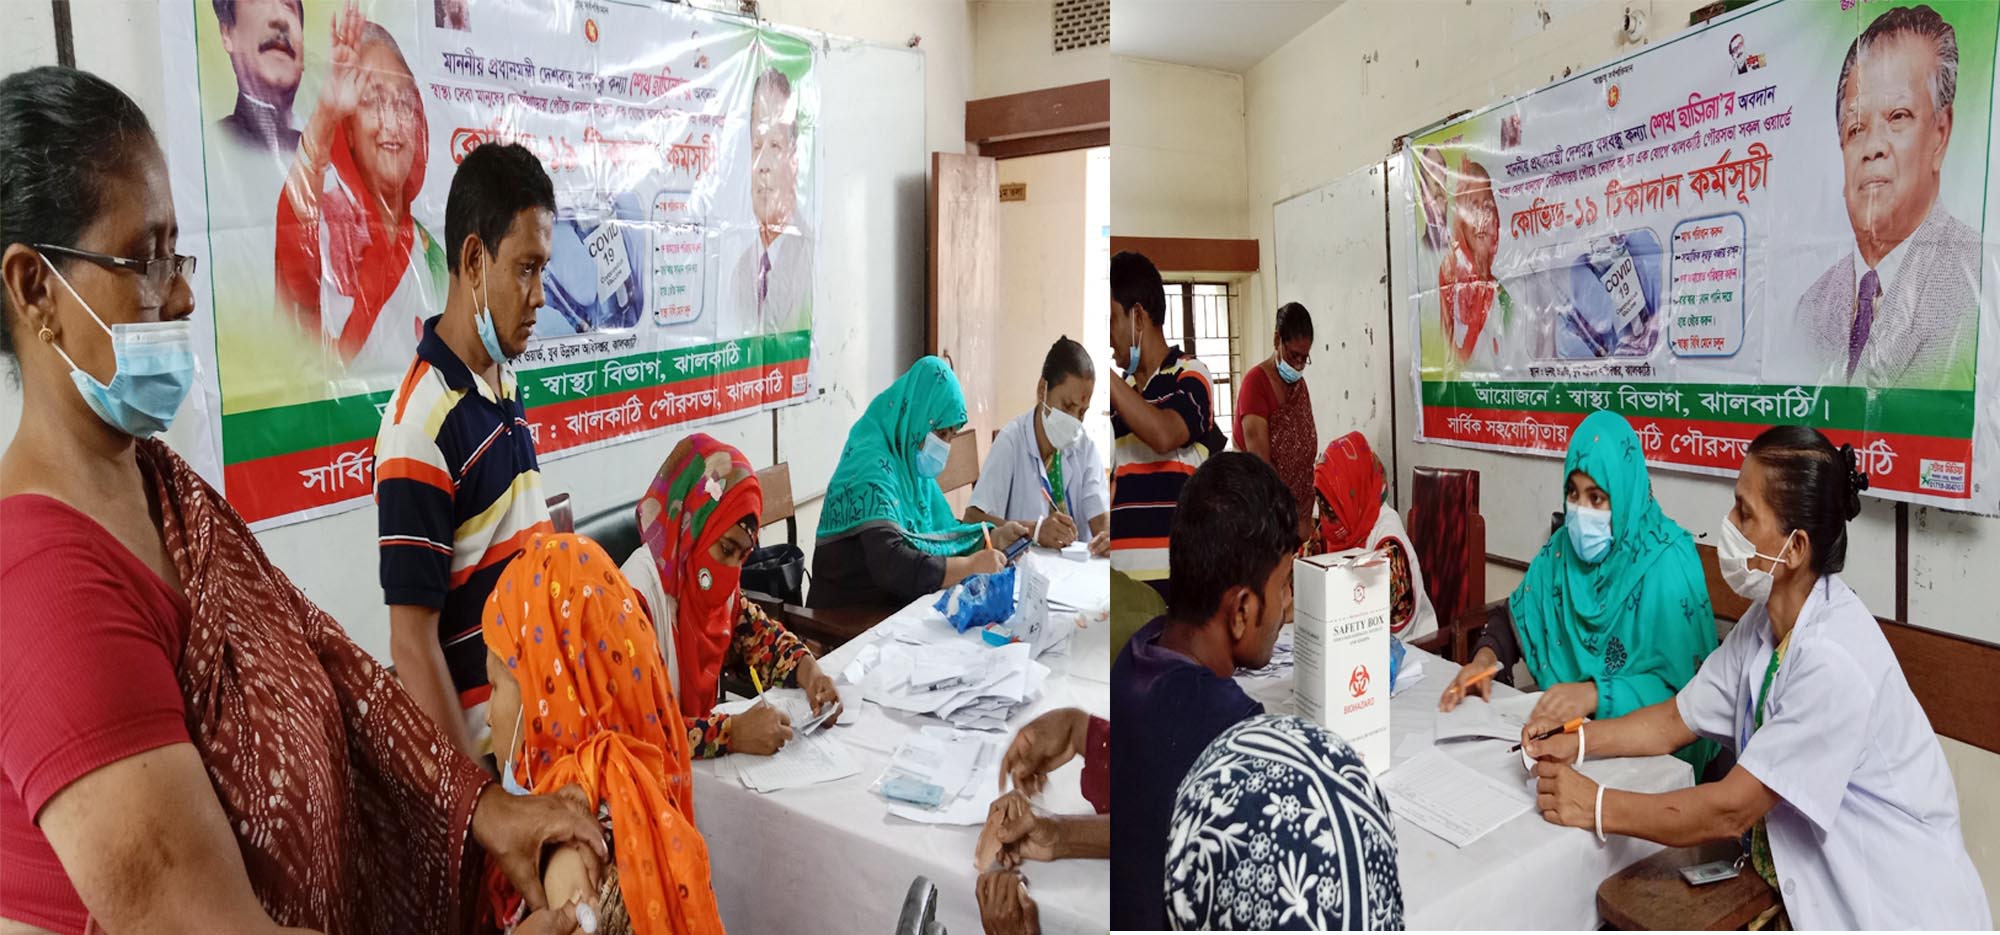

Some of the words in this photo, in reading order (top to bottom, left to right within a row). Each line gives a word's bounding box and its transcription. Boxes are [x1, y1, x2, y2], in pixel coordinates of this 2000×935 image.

[442, 47, 484, 77] মাননীয়
[629, 72, 653, 96] শেখ
[1566, 141, 1594, 161] দেশরত্ন
[1597, 131, 1625, 154] বঙ্গবন্ধু
[1625, 124, 1647, 144] কন্যা
[1650, 111, 1676, 139] শেখ
[1738, 84, 1777, 111] অবদান
[1671, 131, 1701, 154] ঝালকাঠি
[1703, 125, 1737, 147] পৌরসভা
[1738, 119, 1761, 138] সকল
[1763, 105, 1793, 131] ওয়ার্ডে
[1604, 178, 1683, 219] টিকাদান
[1687, 142, 1774, 205] কর্মসূচী
[588, 222, 619, 258] COVID
[603, 247, 615, 266] 19
[1605, 258, 1632, 293] COVID
[1619, 282, 1630, 299] 19
[540, 370, 598, 396] স্বাস্থ্য
[602, 360, 666, 388] বিভাগ,
[672, 339, 741, 376] ঝালকাঠি
[564, 395, 643, 437] ঝালকাঠি
[649, 389, 723, 420] পৌরসভা,
[725, 367, 784, 400] ঝালকাঠি
[1474, 384, 1549, 406] আয়োজনে
[1567, 389, 1613, 410] স্বাস্থ্য
[1616, 384, 1690, 417] বিভাগ,
[1699, 386, 1817, 419] ঝালকাঠি
[1447, 413, 1482, 436] সার্বিক
[1484, 416, 1569, 443] সহযোগিতায়
[1333, 620, 1365, 636] SAFETY
[1367, 614, 1384, 628] BOX
[1343, 696, 1375, 715] BIOHAZARD
